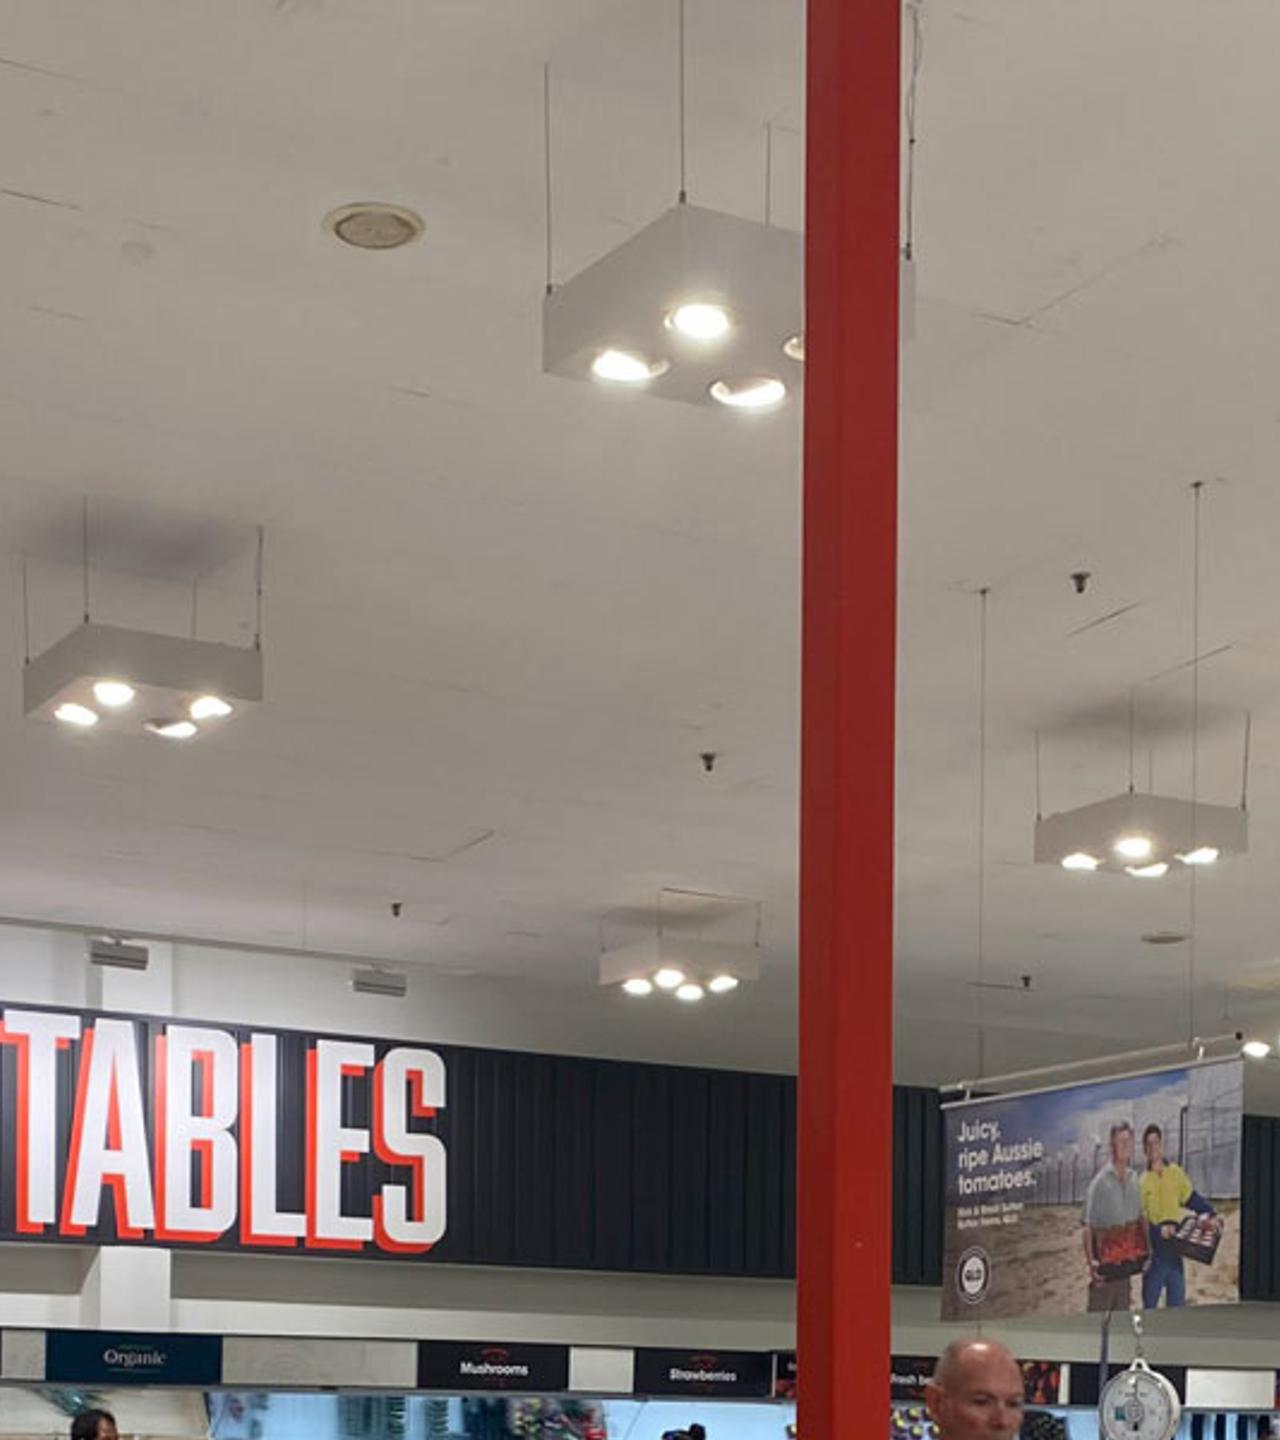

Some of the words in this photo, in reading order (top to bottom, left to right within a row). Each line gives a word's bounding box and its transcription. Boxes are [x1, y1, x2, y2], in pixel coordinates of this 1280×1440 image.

[959, 1147, 989, 1172] ripe
[992, 1137, 1044, 1164] Aussie
[959, 1169, 1038, 1195] tomatoes.
[102, 1348, 167, 1368] Organic
[460, 1361, 529, 1376] Mushrooms
[669, 1367, 737, 1383] Strawberries
